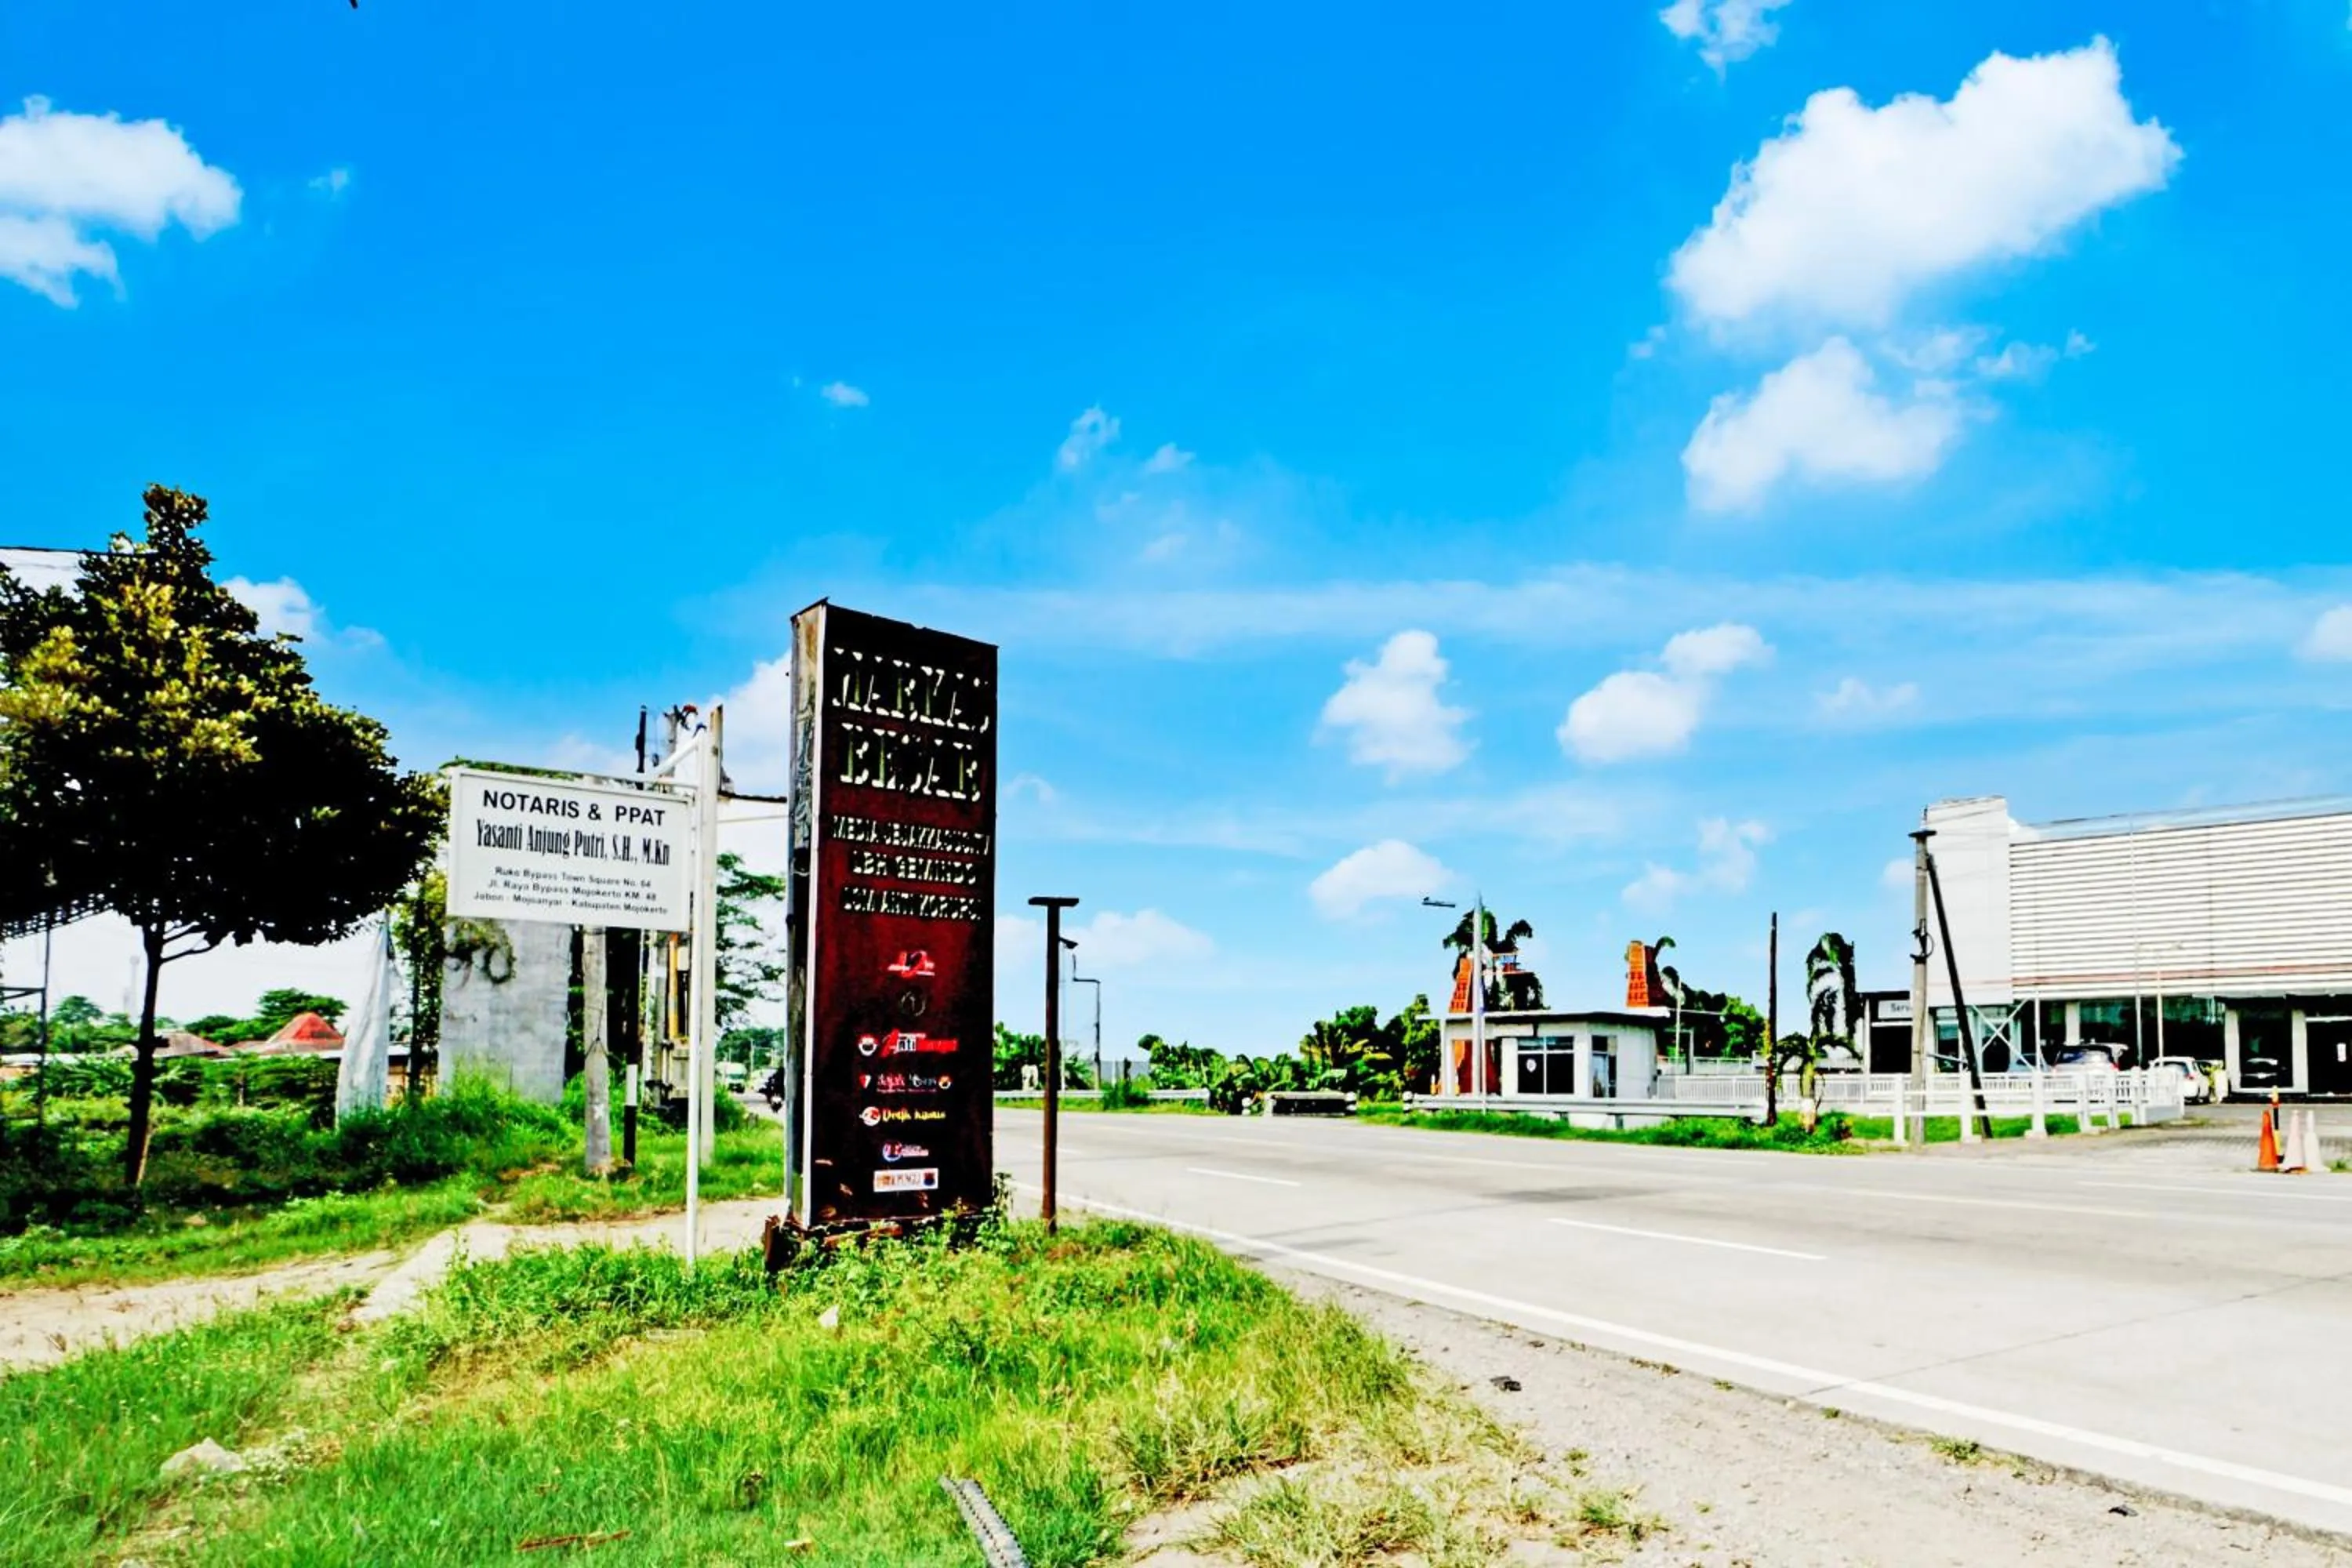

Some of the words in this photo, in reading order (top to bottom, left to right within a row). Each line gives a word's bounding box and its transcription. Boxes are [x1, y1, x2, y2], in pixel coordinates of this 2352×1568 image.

[483, 789, 579, 818] NOTARIS
[587, 803, 601, 821] &
[615, 805, 666, 826] PPAT
[477, 818, 522, 851] Yasanti
[526, 825, 570, 859] Anjung
[574, 829, 608, 861] Putri,
[612, 833, 637, 865] S.H.,
[532, 883, 569, 895] Bypass
[572, 886, 622, 898] Mojokerto
[623, 902, 669, 915] Mojokerto
